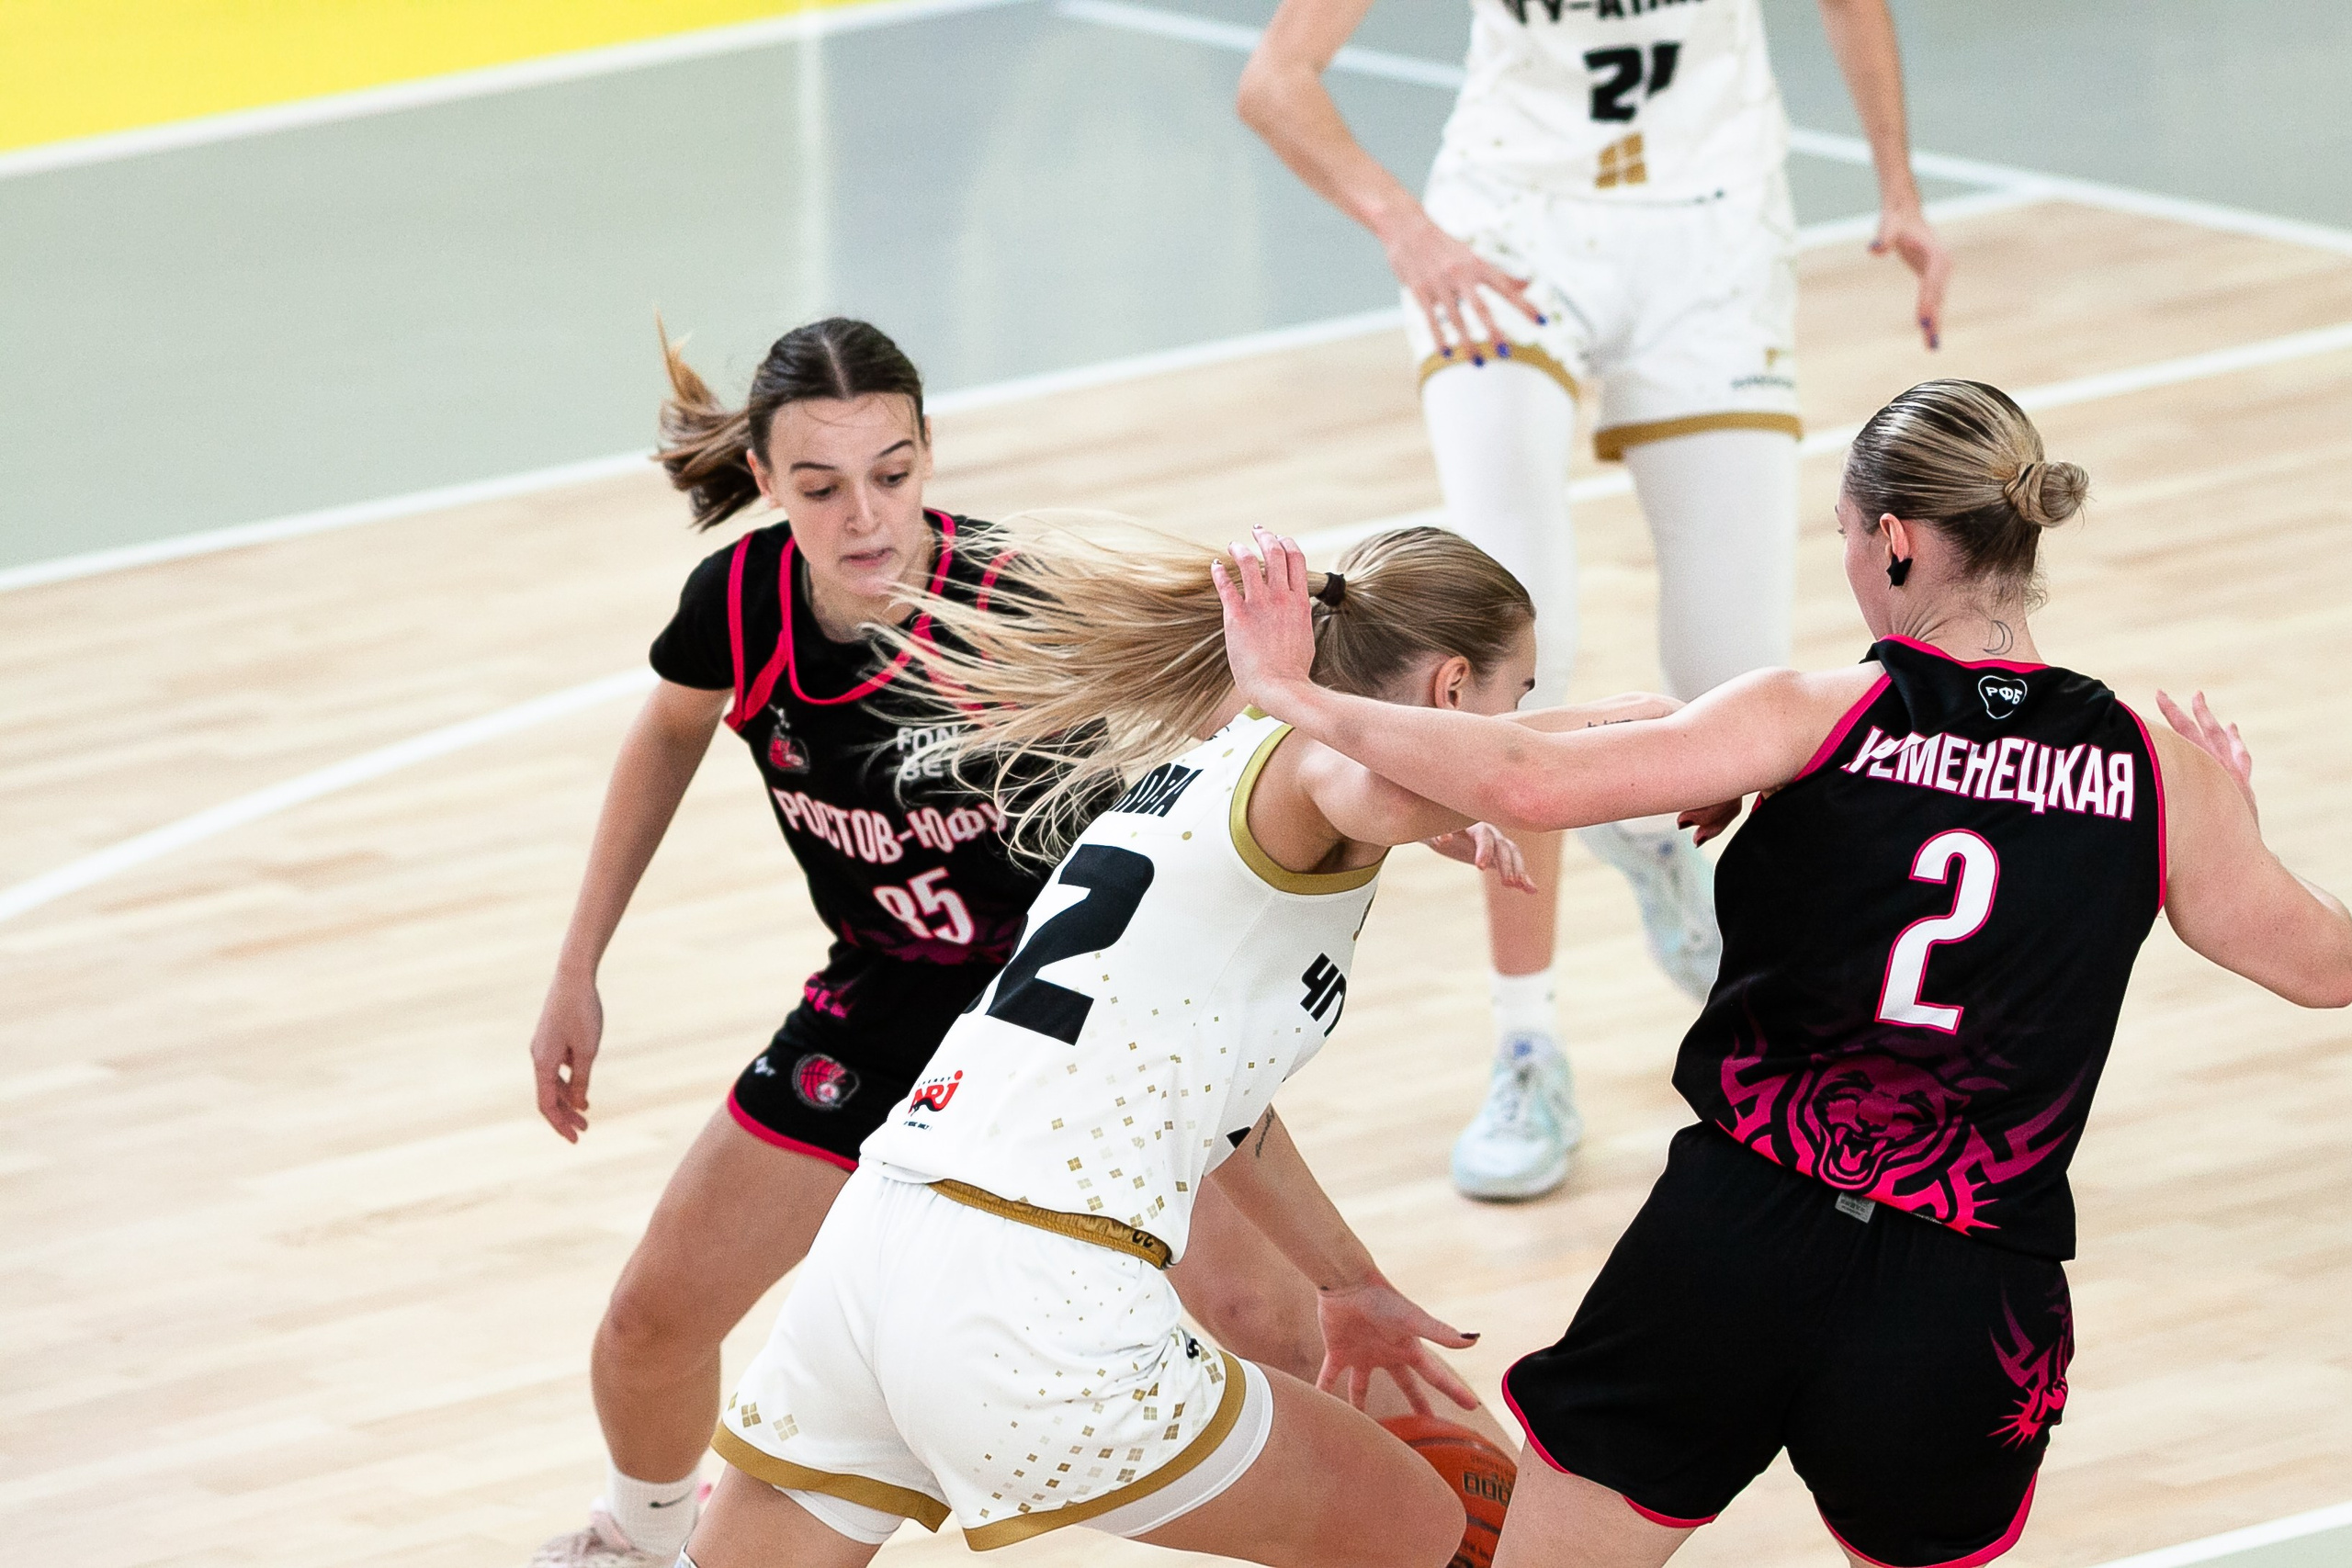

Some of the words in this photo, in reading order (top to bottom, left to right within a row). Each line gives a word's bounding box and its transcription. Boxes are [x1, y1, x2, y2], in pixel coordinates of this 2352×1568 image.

[1984, 685, 2024, 705] РФБ
[959, 844, 1156, 1047] 2
[1874, 828, 2000, 1035] 2
